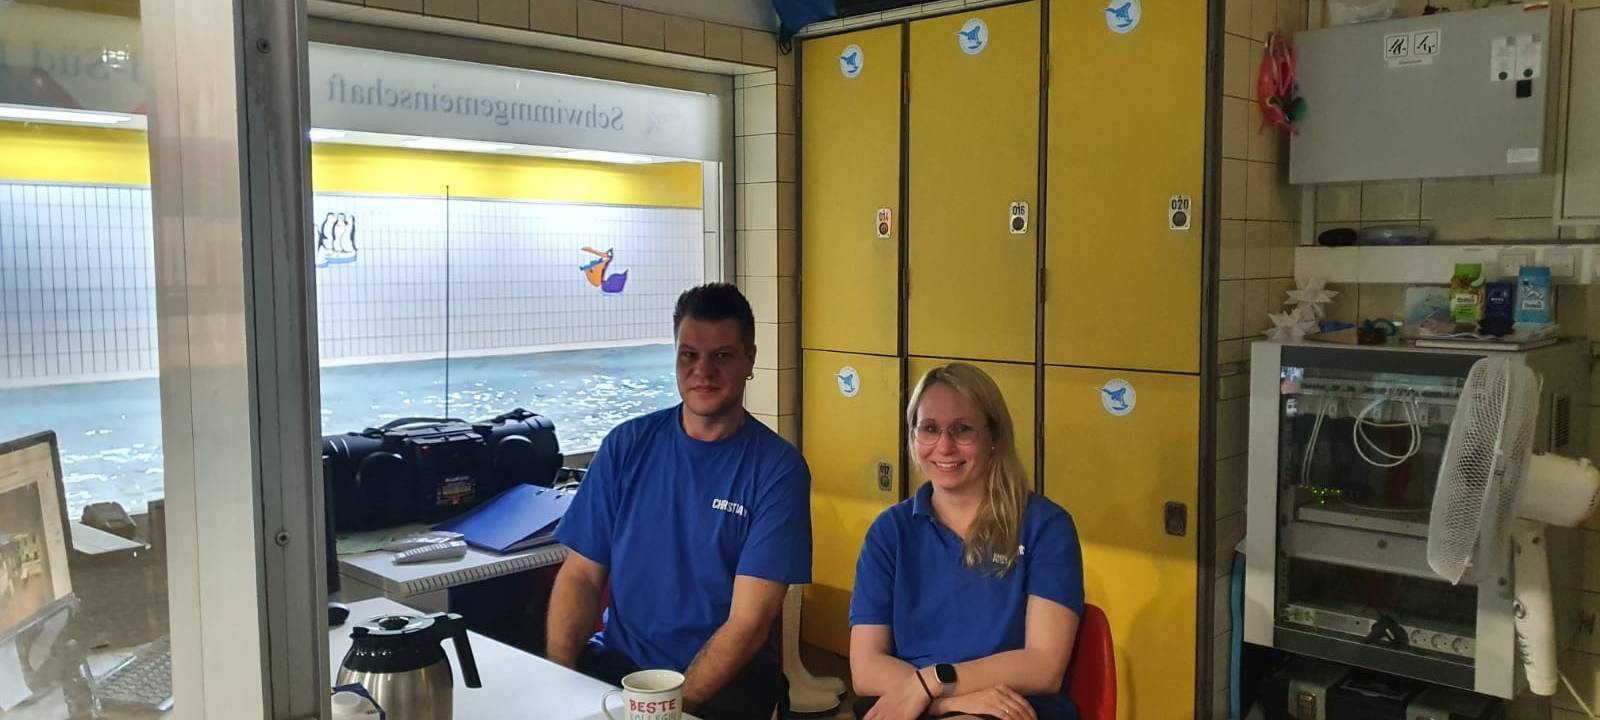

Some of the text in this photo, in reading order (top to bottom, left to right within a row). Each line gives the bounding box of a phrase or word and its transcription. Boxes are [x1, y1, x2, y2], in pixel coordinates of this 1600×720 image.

[1171, 198, 1189, 210] 020
[711, 498, 748, 518] CHRSTIA
[629, 698, 676, 714] BESTE
